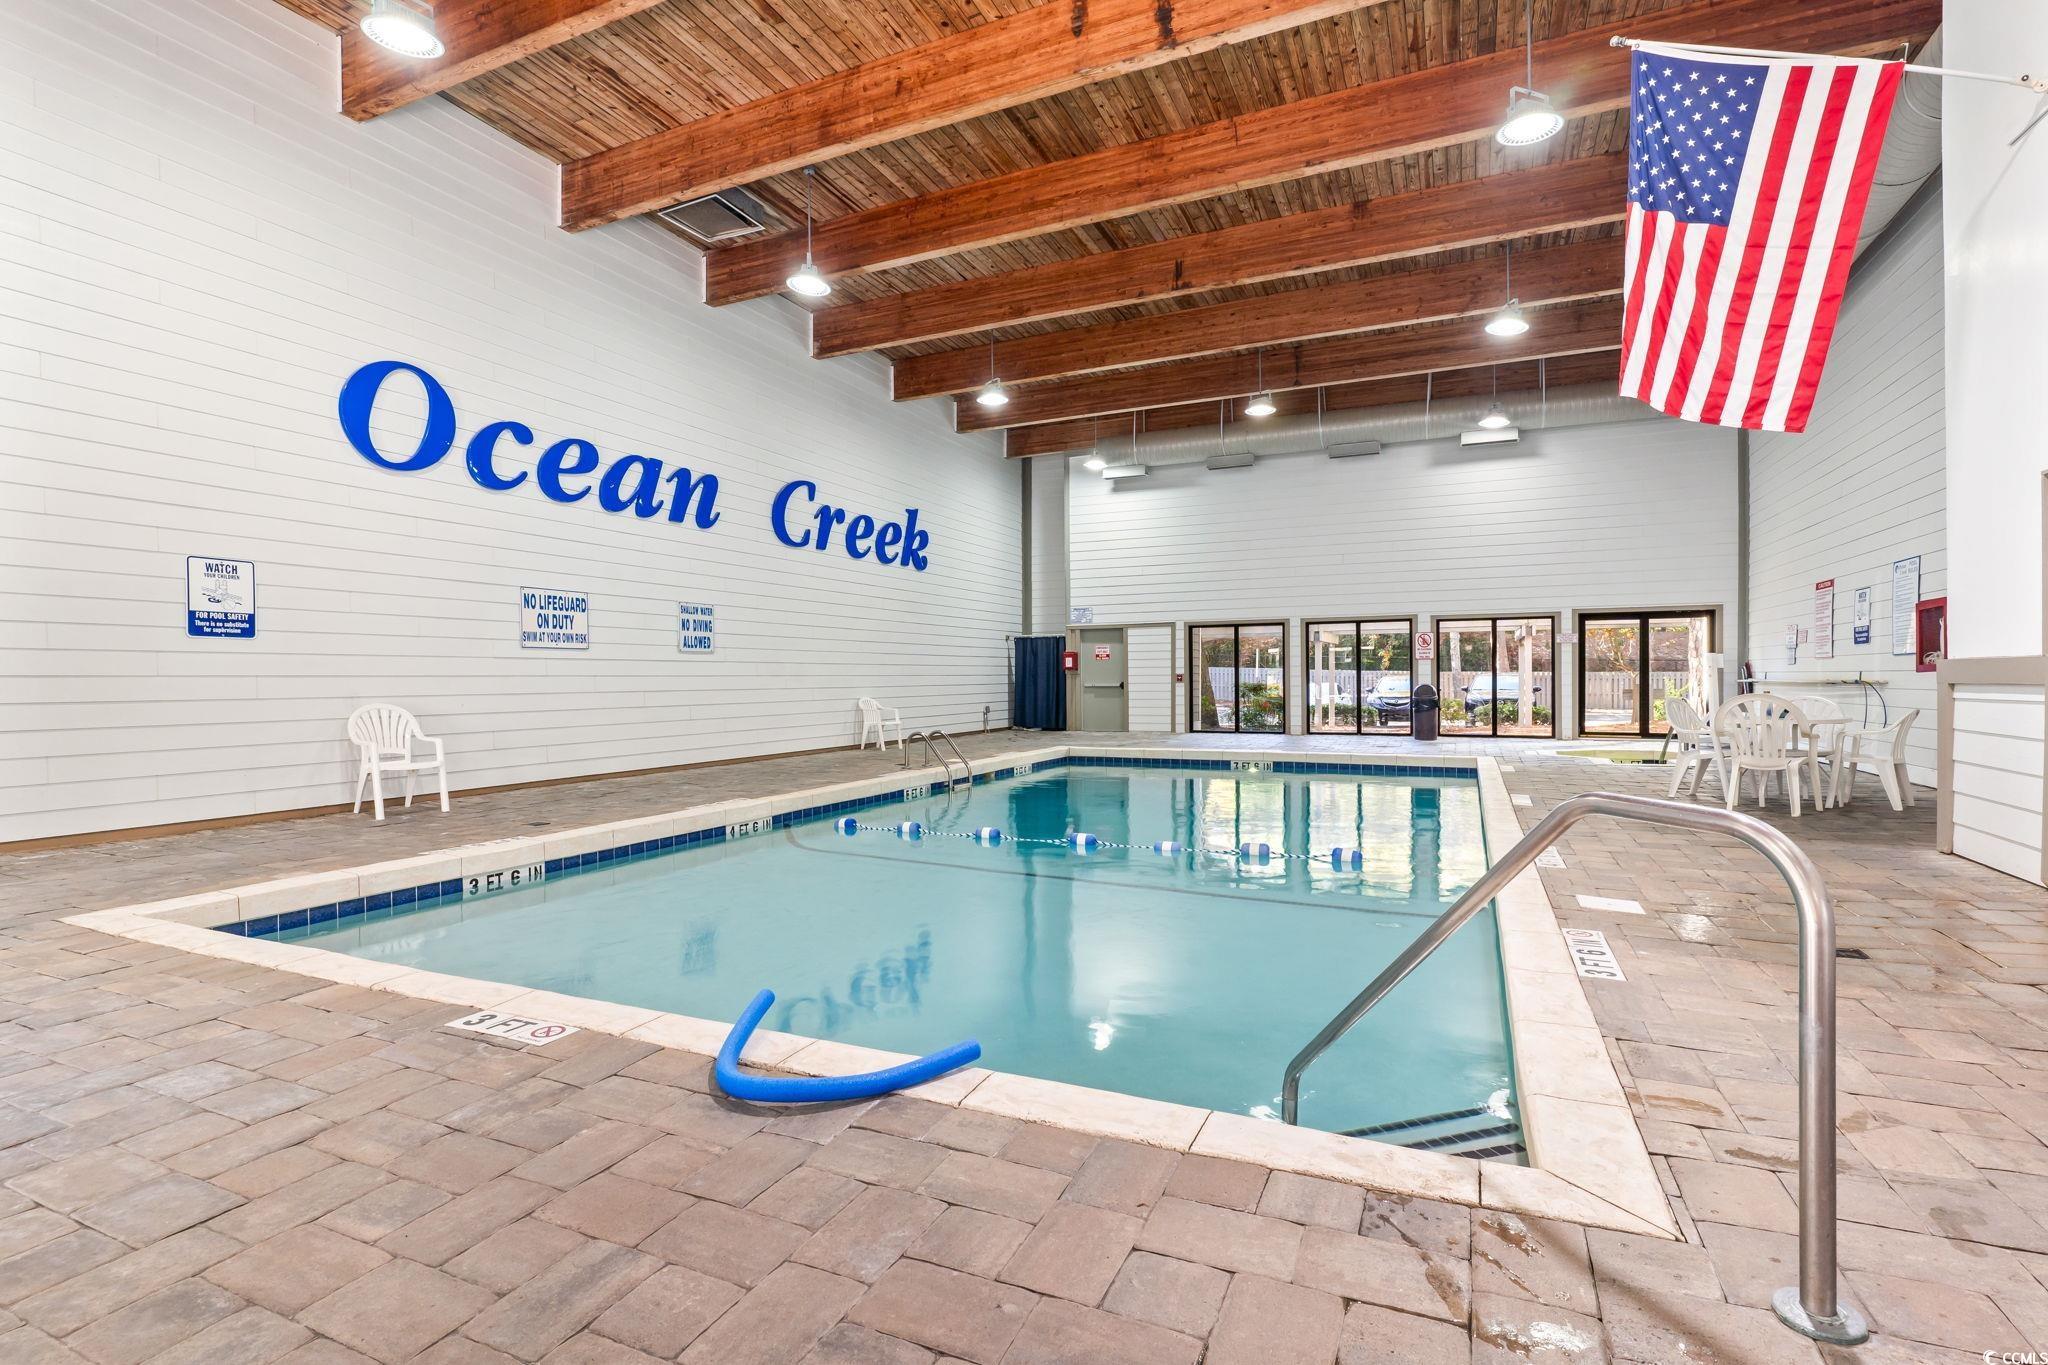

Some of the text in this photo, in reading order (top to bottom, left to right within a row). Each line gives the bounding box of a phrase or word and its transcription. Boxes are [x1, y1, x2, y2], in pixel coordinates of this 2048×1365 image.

[338, 360, 930, 571] Ocean Creek
[205, 562, 238, 575] WATCH
[523, 593, 587, 613] NO LIFEGUARD
[209, 612, 226, 620] POOL
[227, 613, 249, 621] SAFETY
[680, 605, 713, 616] SHALLOW WATER
[537, 613, 575, 630] ON DUTY
[681, 618, 713, 633] NO DIVING
[522, 631, 588, 644] SWIM AT YOUR OWN RISK
[682, 635, 711, 649] ALLOWED
[762, 819, 771, 831] IN
[469, 878, 479, 895] 3
[528, 865, 543, 882] IN
[1571, 939, 1604, 948] IN
[1579, 957, 1614, 969] FT
[1584, 969, 1617, 977] 3
[462, 1014, 539, 1033] 3 FT
